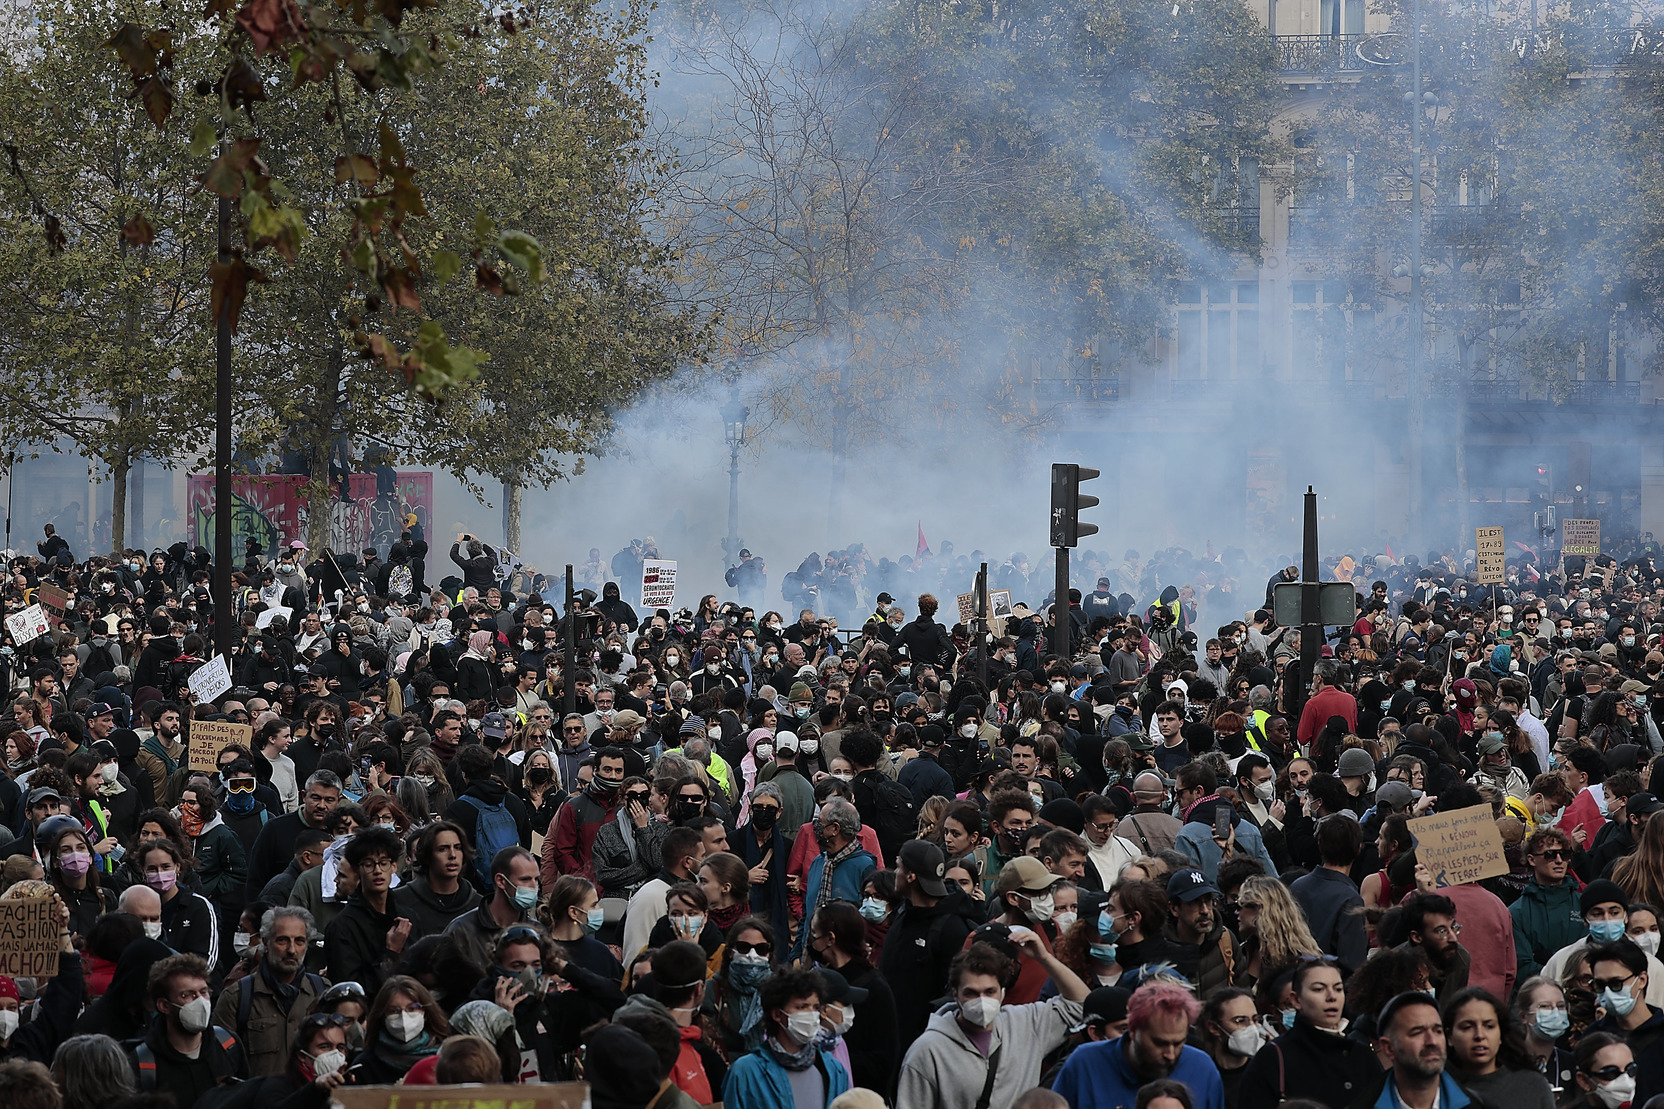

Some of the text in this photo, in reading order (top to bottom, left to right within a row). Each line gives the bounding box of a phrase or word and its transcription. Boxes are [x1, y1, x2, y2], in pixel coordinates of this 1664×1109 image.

[1479, 529, 1501, 538] IL EST
[207, 659, 220, 673] LES
[192, 667, 225, 693] NTROVERTIS
[207, 677, 226, 698] DEHORS
[191, 722, 216, 732] J'FAIS
[191, 733, 229, 742] CAUCHEMARS
[200, 741, 214, 749] DE
[190, 748, 216, 756] MACRON
[191, 756, 215, 765] LA POLI
[1449, 829, 1478, 841] GENOUX
[1480, 840, 1490, 851] ça
[1448, 858, 1462, 870] LES
[1463, 854, 1484, 867] PIEDS
[1485, 851, 1499, 863] SUR
[1190, 872, 1204, 883] NY
[0, 921, 58, 940] ASHION
[23, 940, 58, 952] JAMAIS
